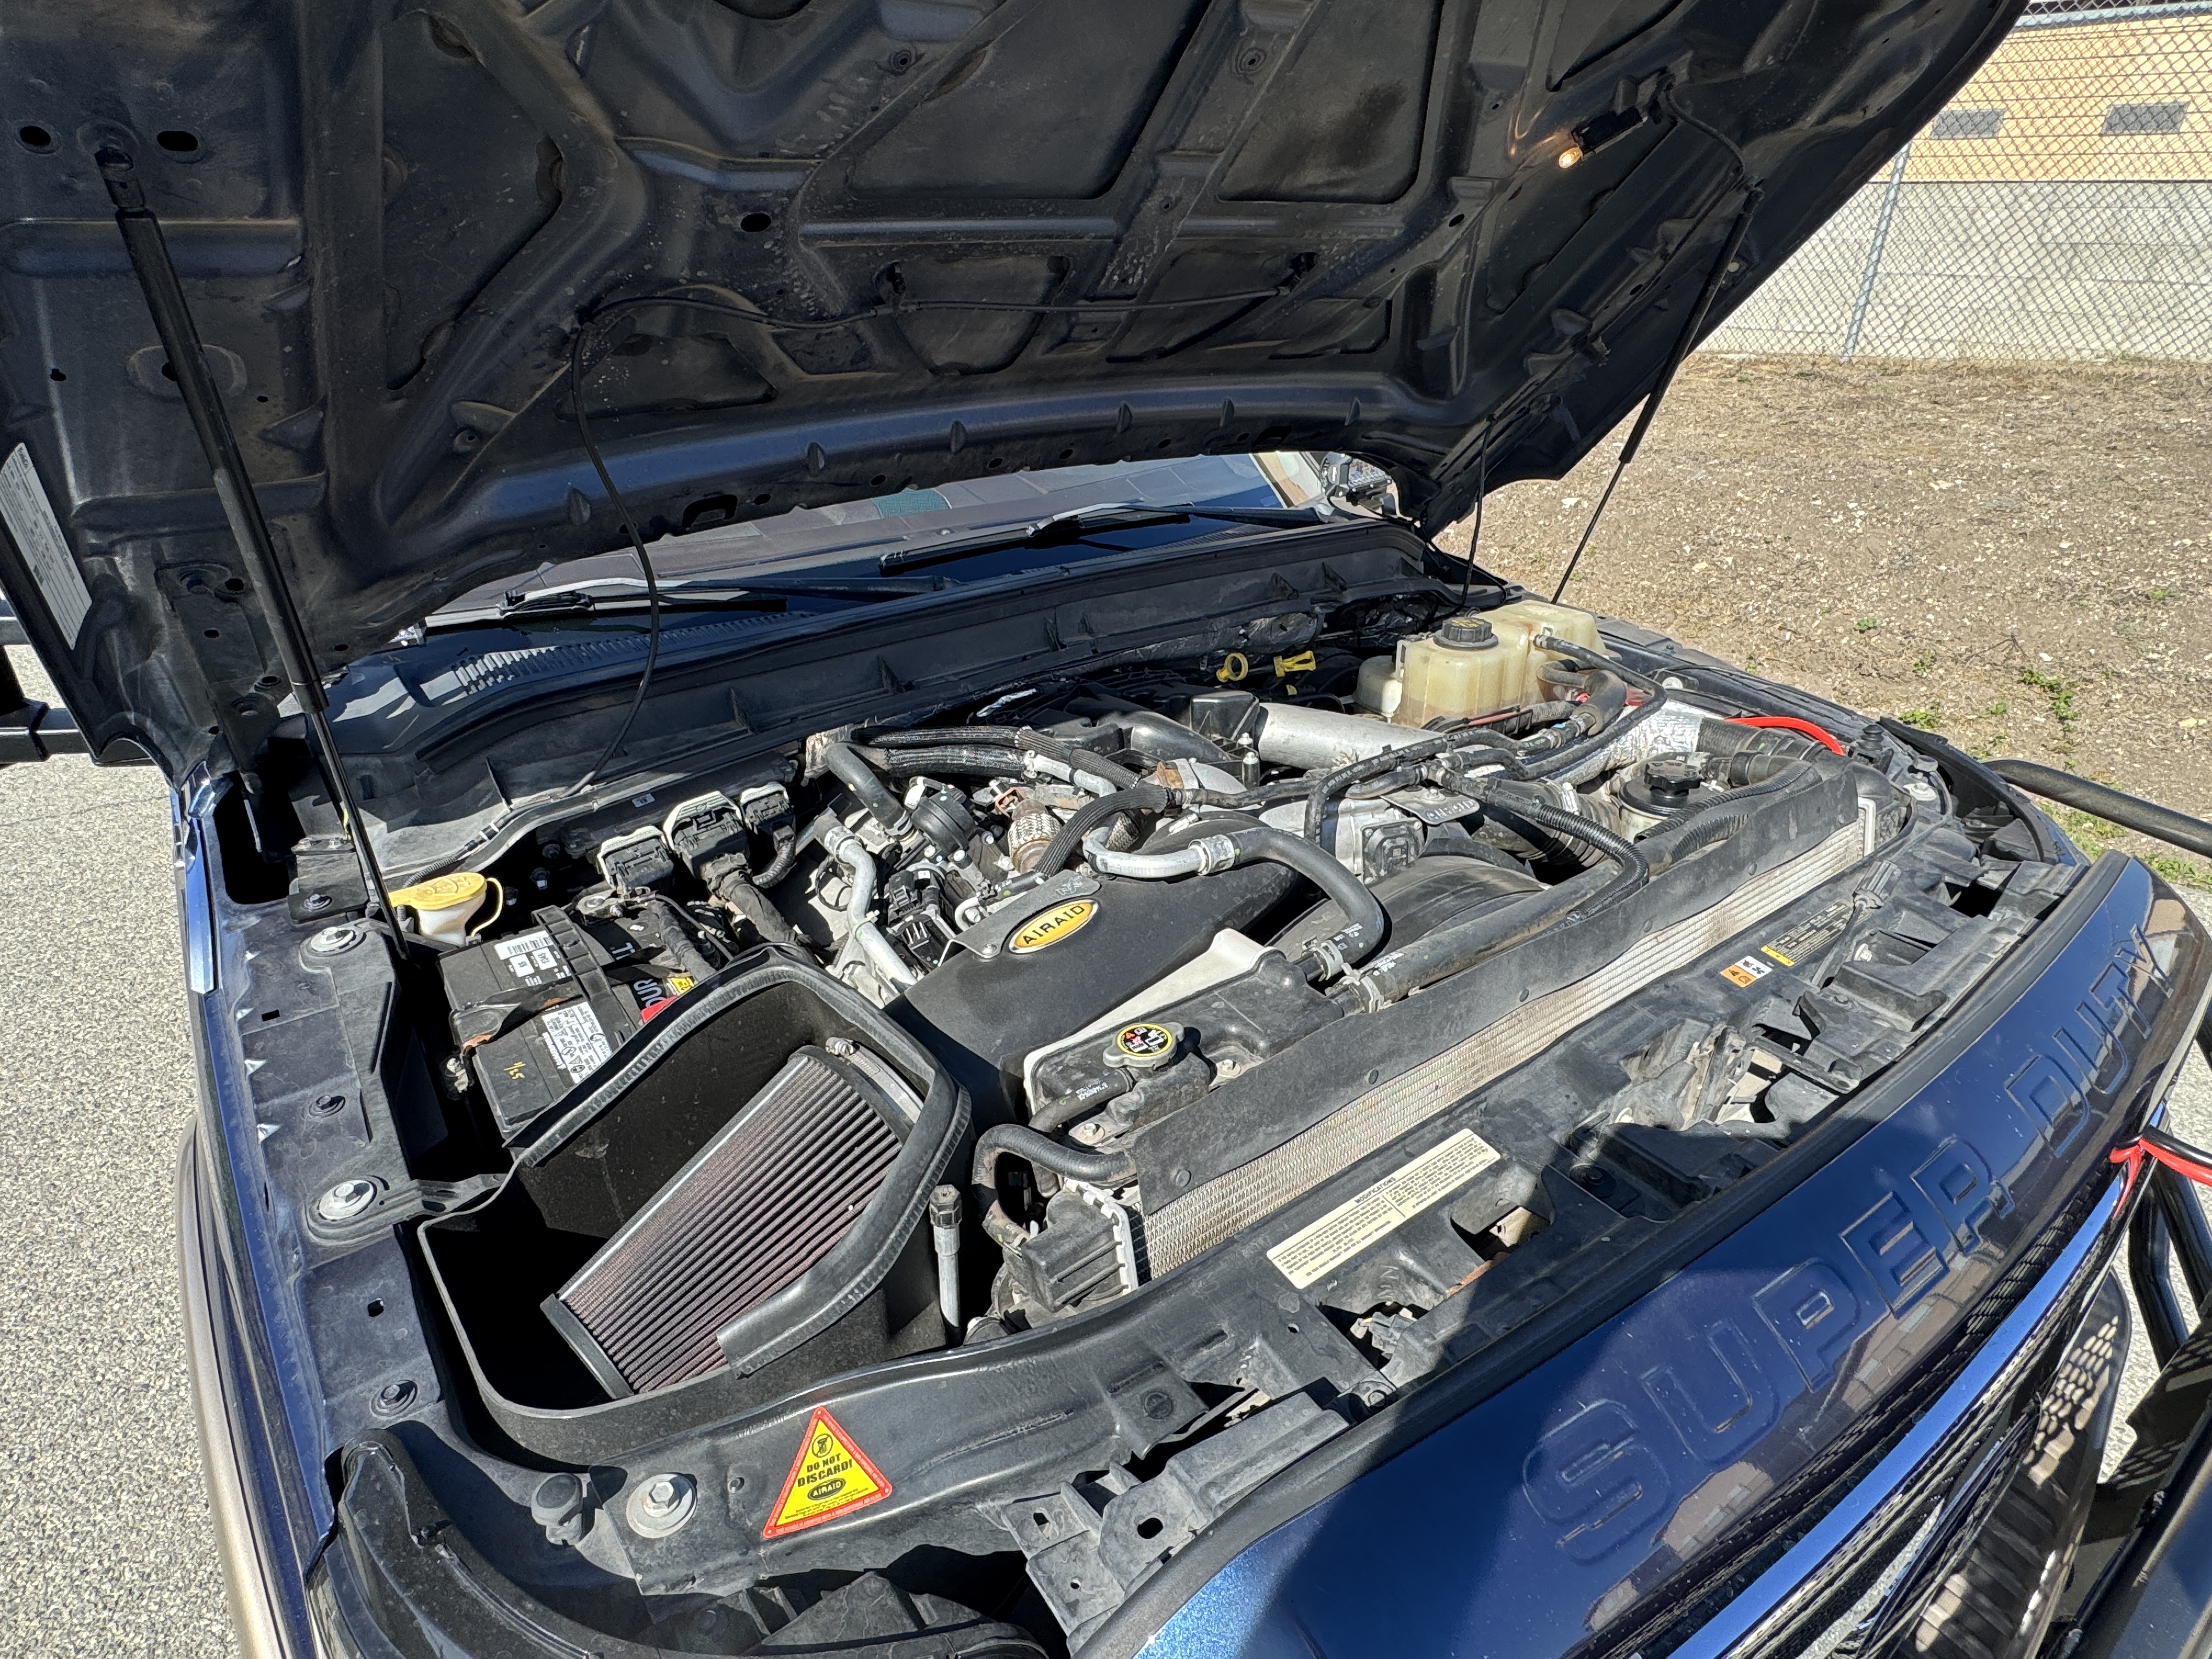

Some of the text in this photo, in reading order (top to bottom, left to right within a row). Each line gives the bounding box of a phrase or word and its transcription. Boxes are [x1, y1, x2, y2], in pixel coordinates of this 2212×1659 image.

[1023, 905, 1085, 944] AIRAID
[1355, 1177, 1396, 1203] MODIFICATIONS
[1522, 1135, 2015, 1565] SUPER
[2004, 923, 2175, 1158] DUTY
[798, 1459, 853, 1487] DISCARD!
[806, 1453, 841, 1472] DO NOT
[812, 1481, 841, 1497] AIRAID
